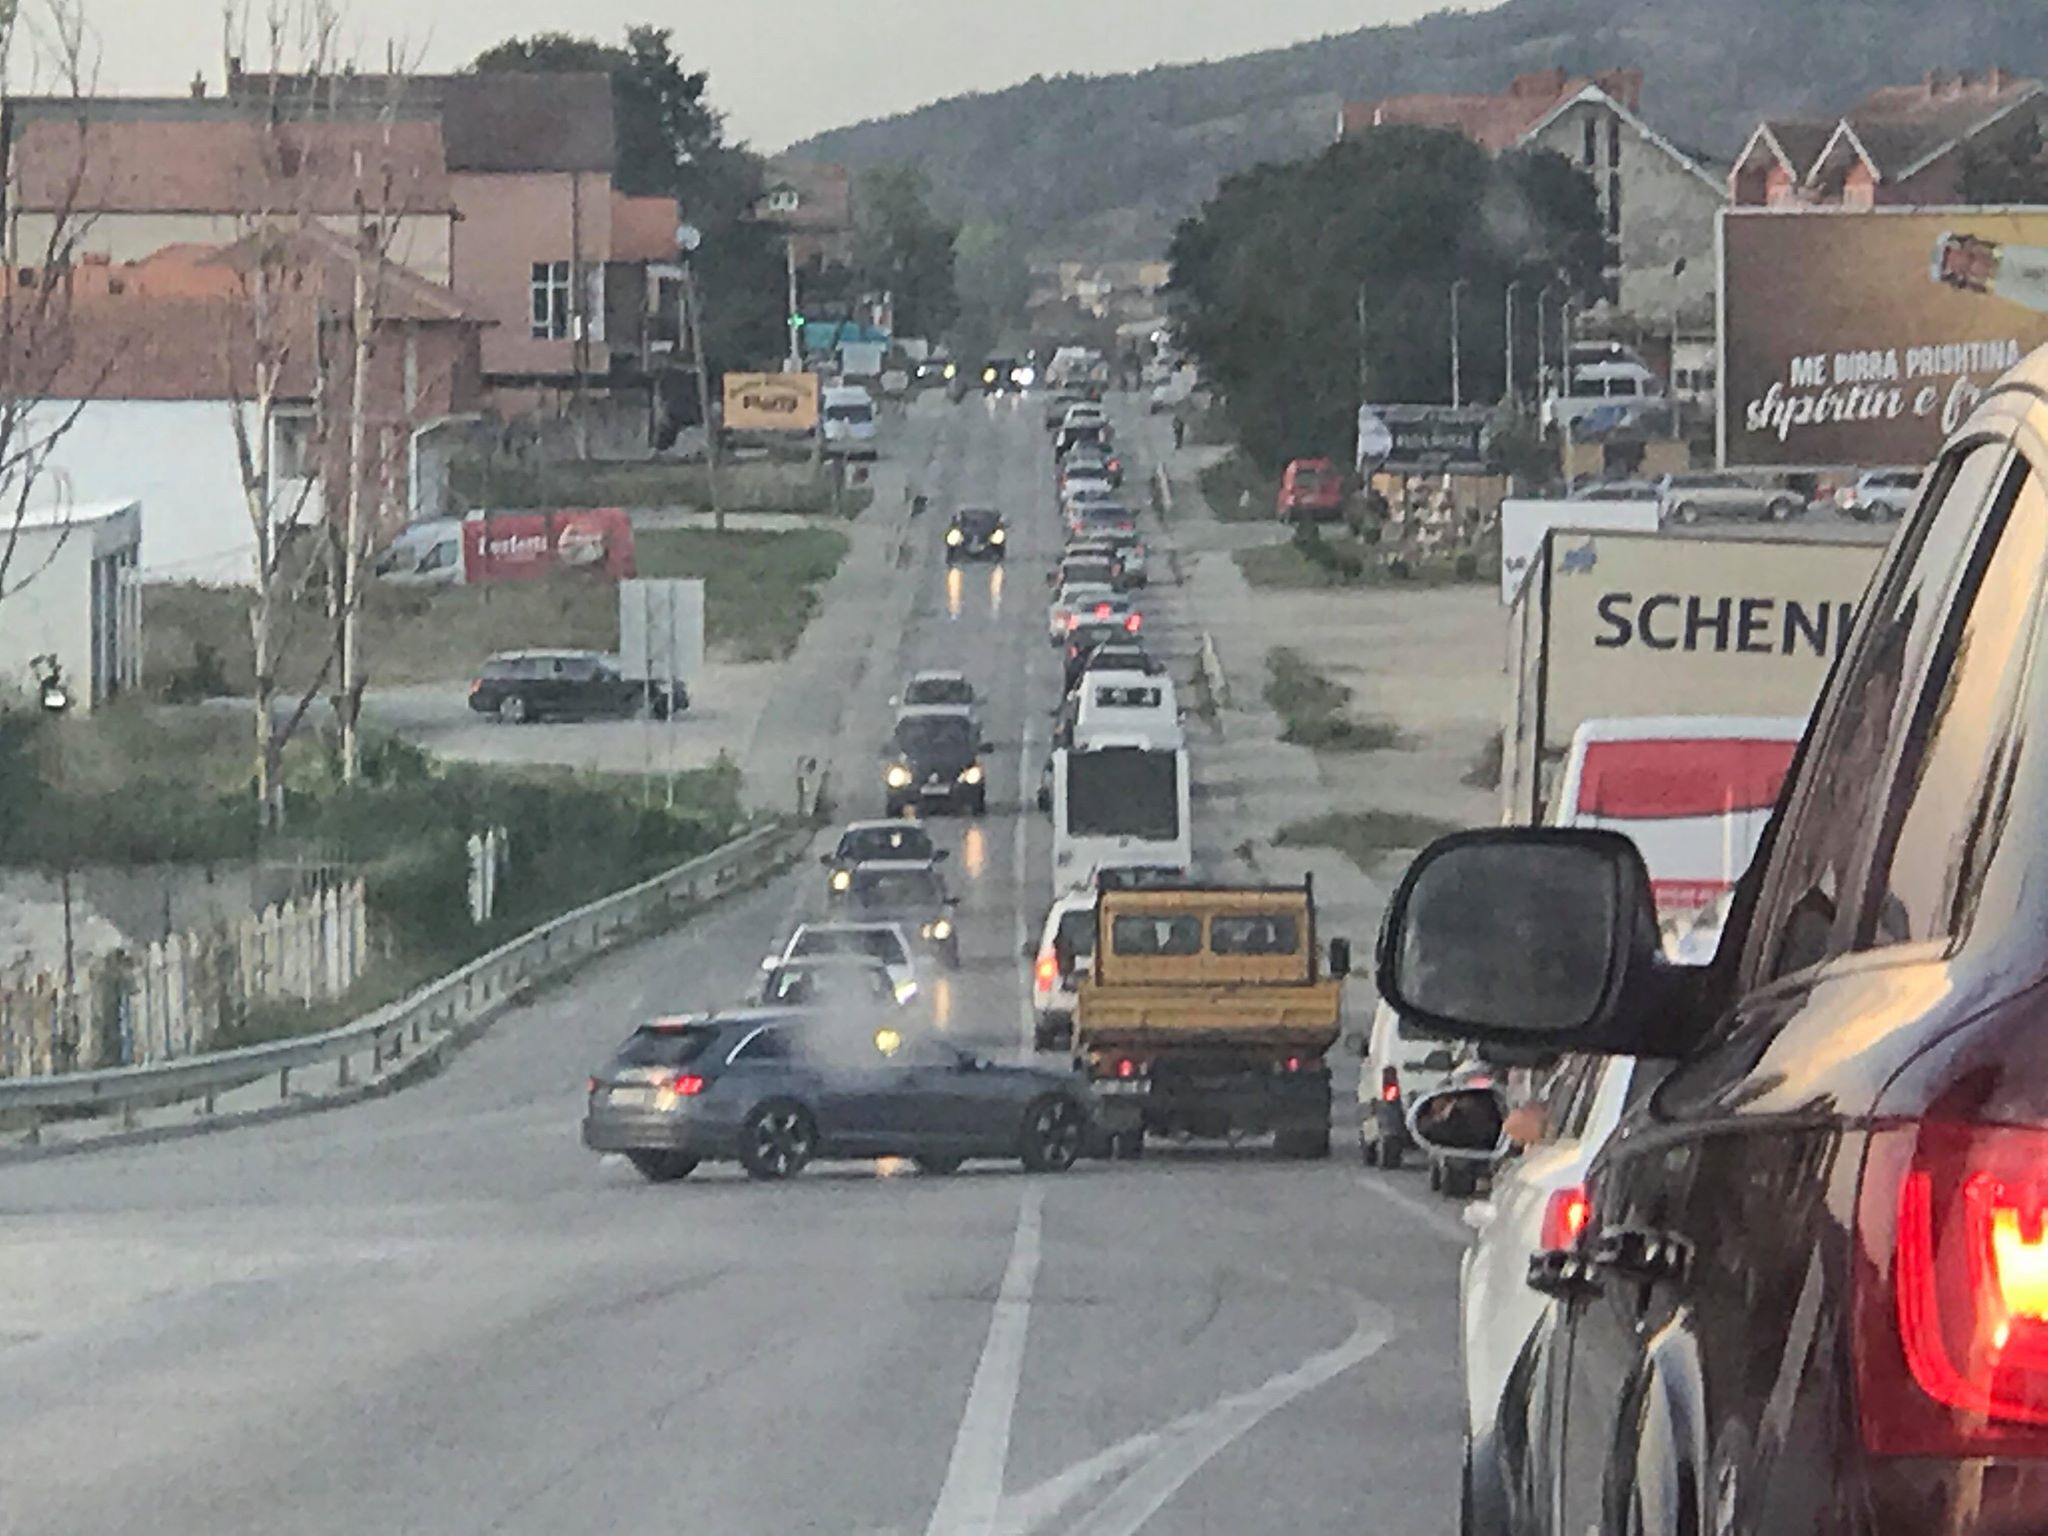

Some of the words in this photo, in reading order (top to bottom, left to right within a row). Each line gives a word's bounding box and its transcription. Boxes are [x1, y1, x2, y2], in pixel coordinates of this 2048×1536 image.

[1790, 354, 1827, 387] ME
[1834, 349, 1899, 383] BIRRA
[1913, 386, 1937, 416] e
